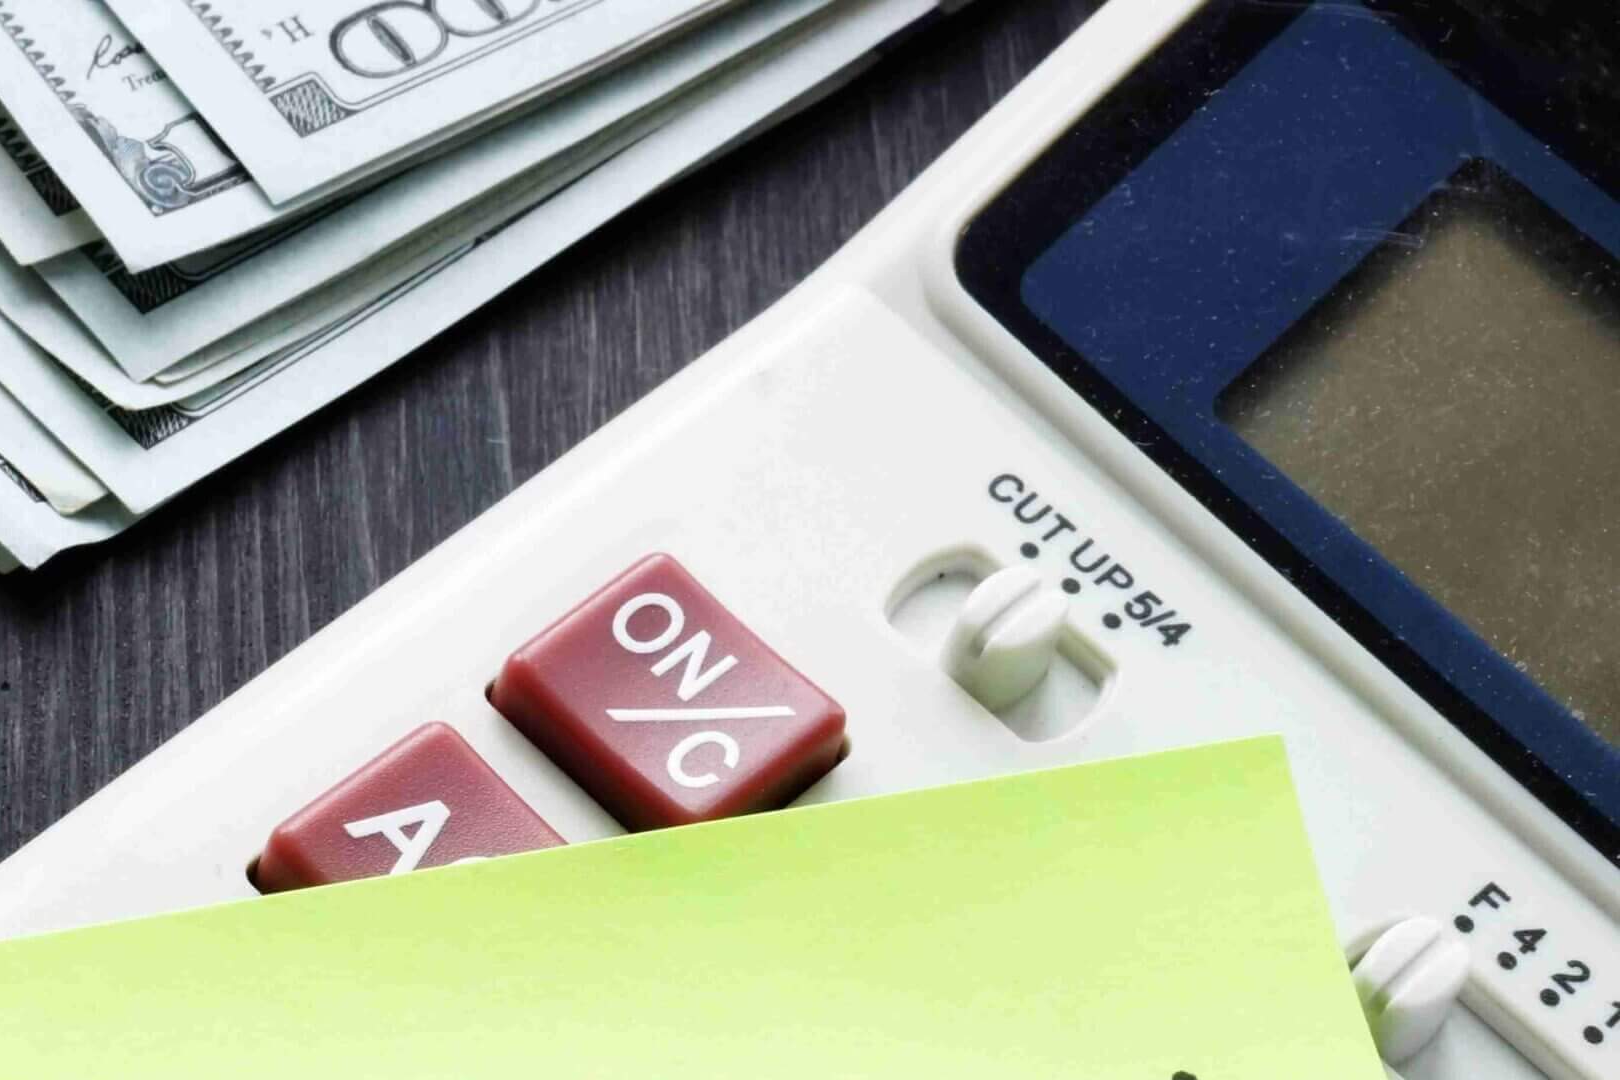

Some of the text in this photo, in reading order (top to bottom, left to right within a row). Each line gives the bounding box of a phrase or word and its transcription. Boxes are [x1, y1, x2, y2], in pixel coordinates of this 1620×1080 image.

[987, 474, 1192, 647] CUT UP 5/4
[343, 799, 490, 879] A
[1468, 881, 1512, 910] F
[1512, 928, 1548, 955] 4
[1550, 959, 1592, 996] 2
